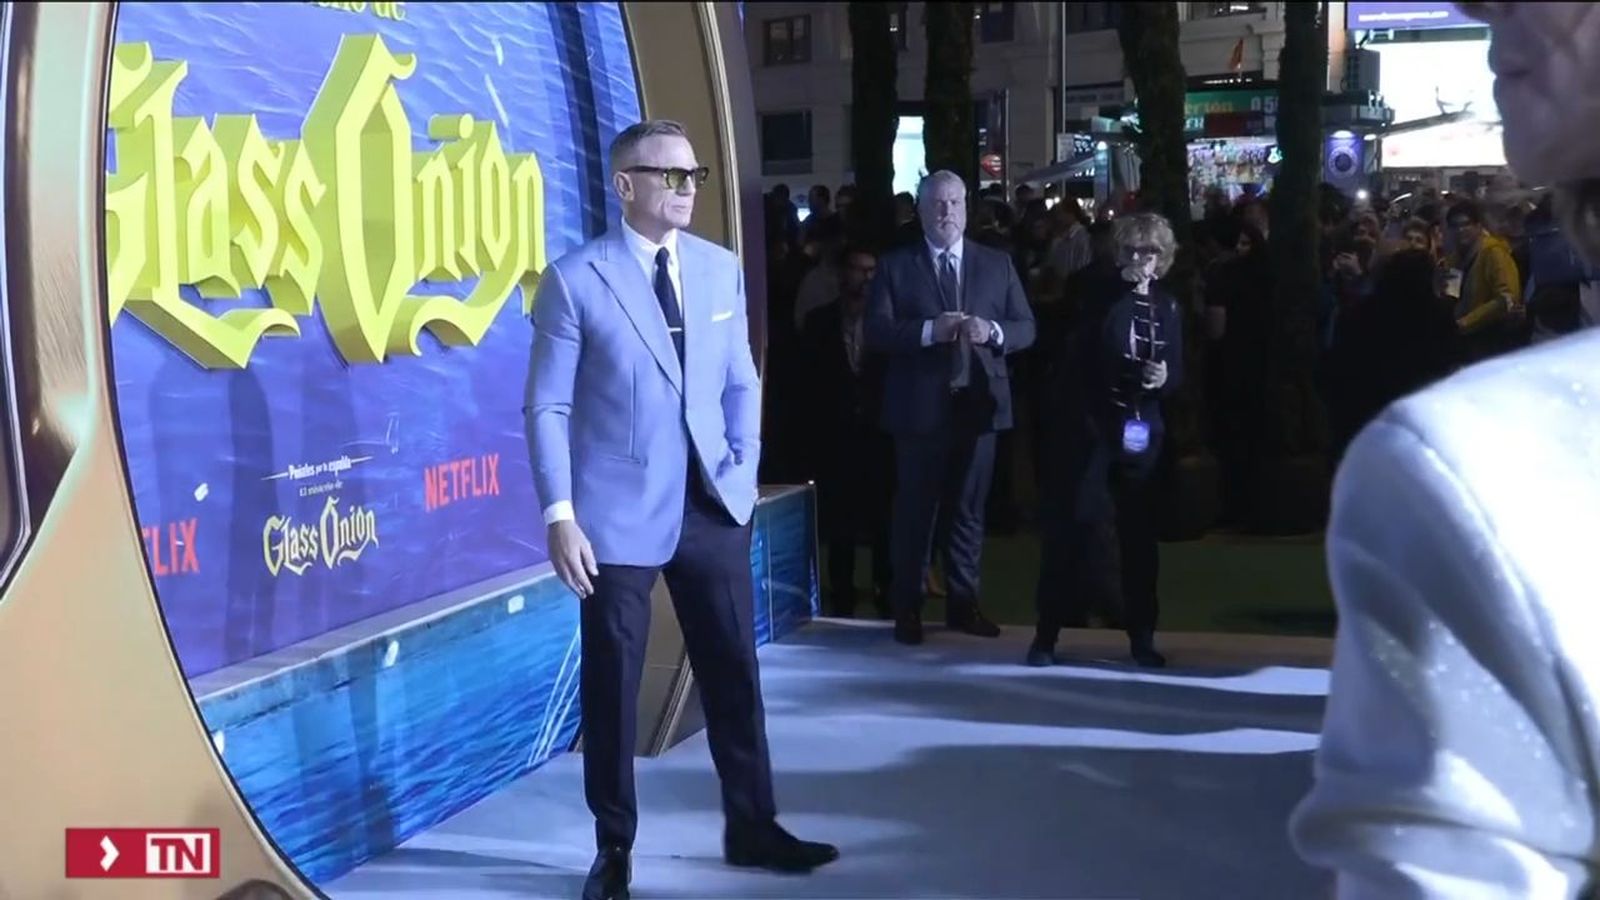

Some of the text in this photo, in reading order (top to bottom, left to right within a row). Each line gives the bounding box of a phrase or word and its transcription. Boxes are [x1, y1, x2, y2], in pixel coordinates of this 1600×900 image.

[325, 33, 547, 364] Onion
[424, 453, 500, 513] NETFLIX
[263, 495, 379, 576] Glass Onion
